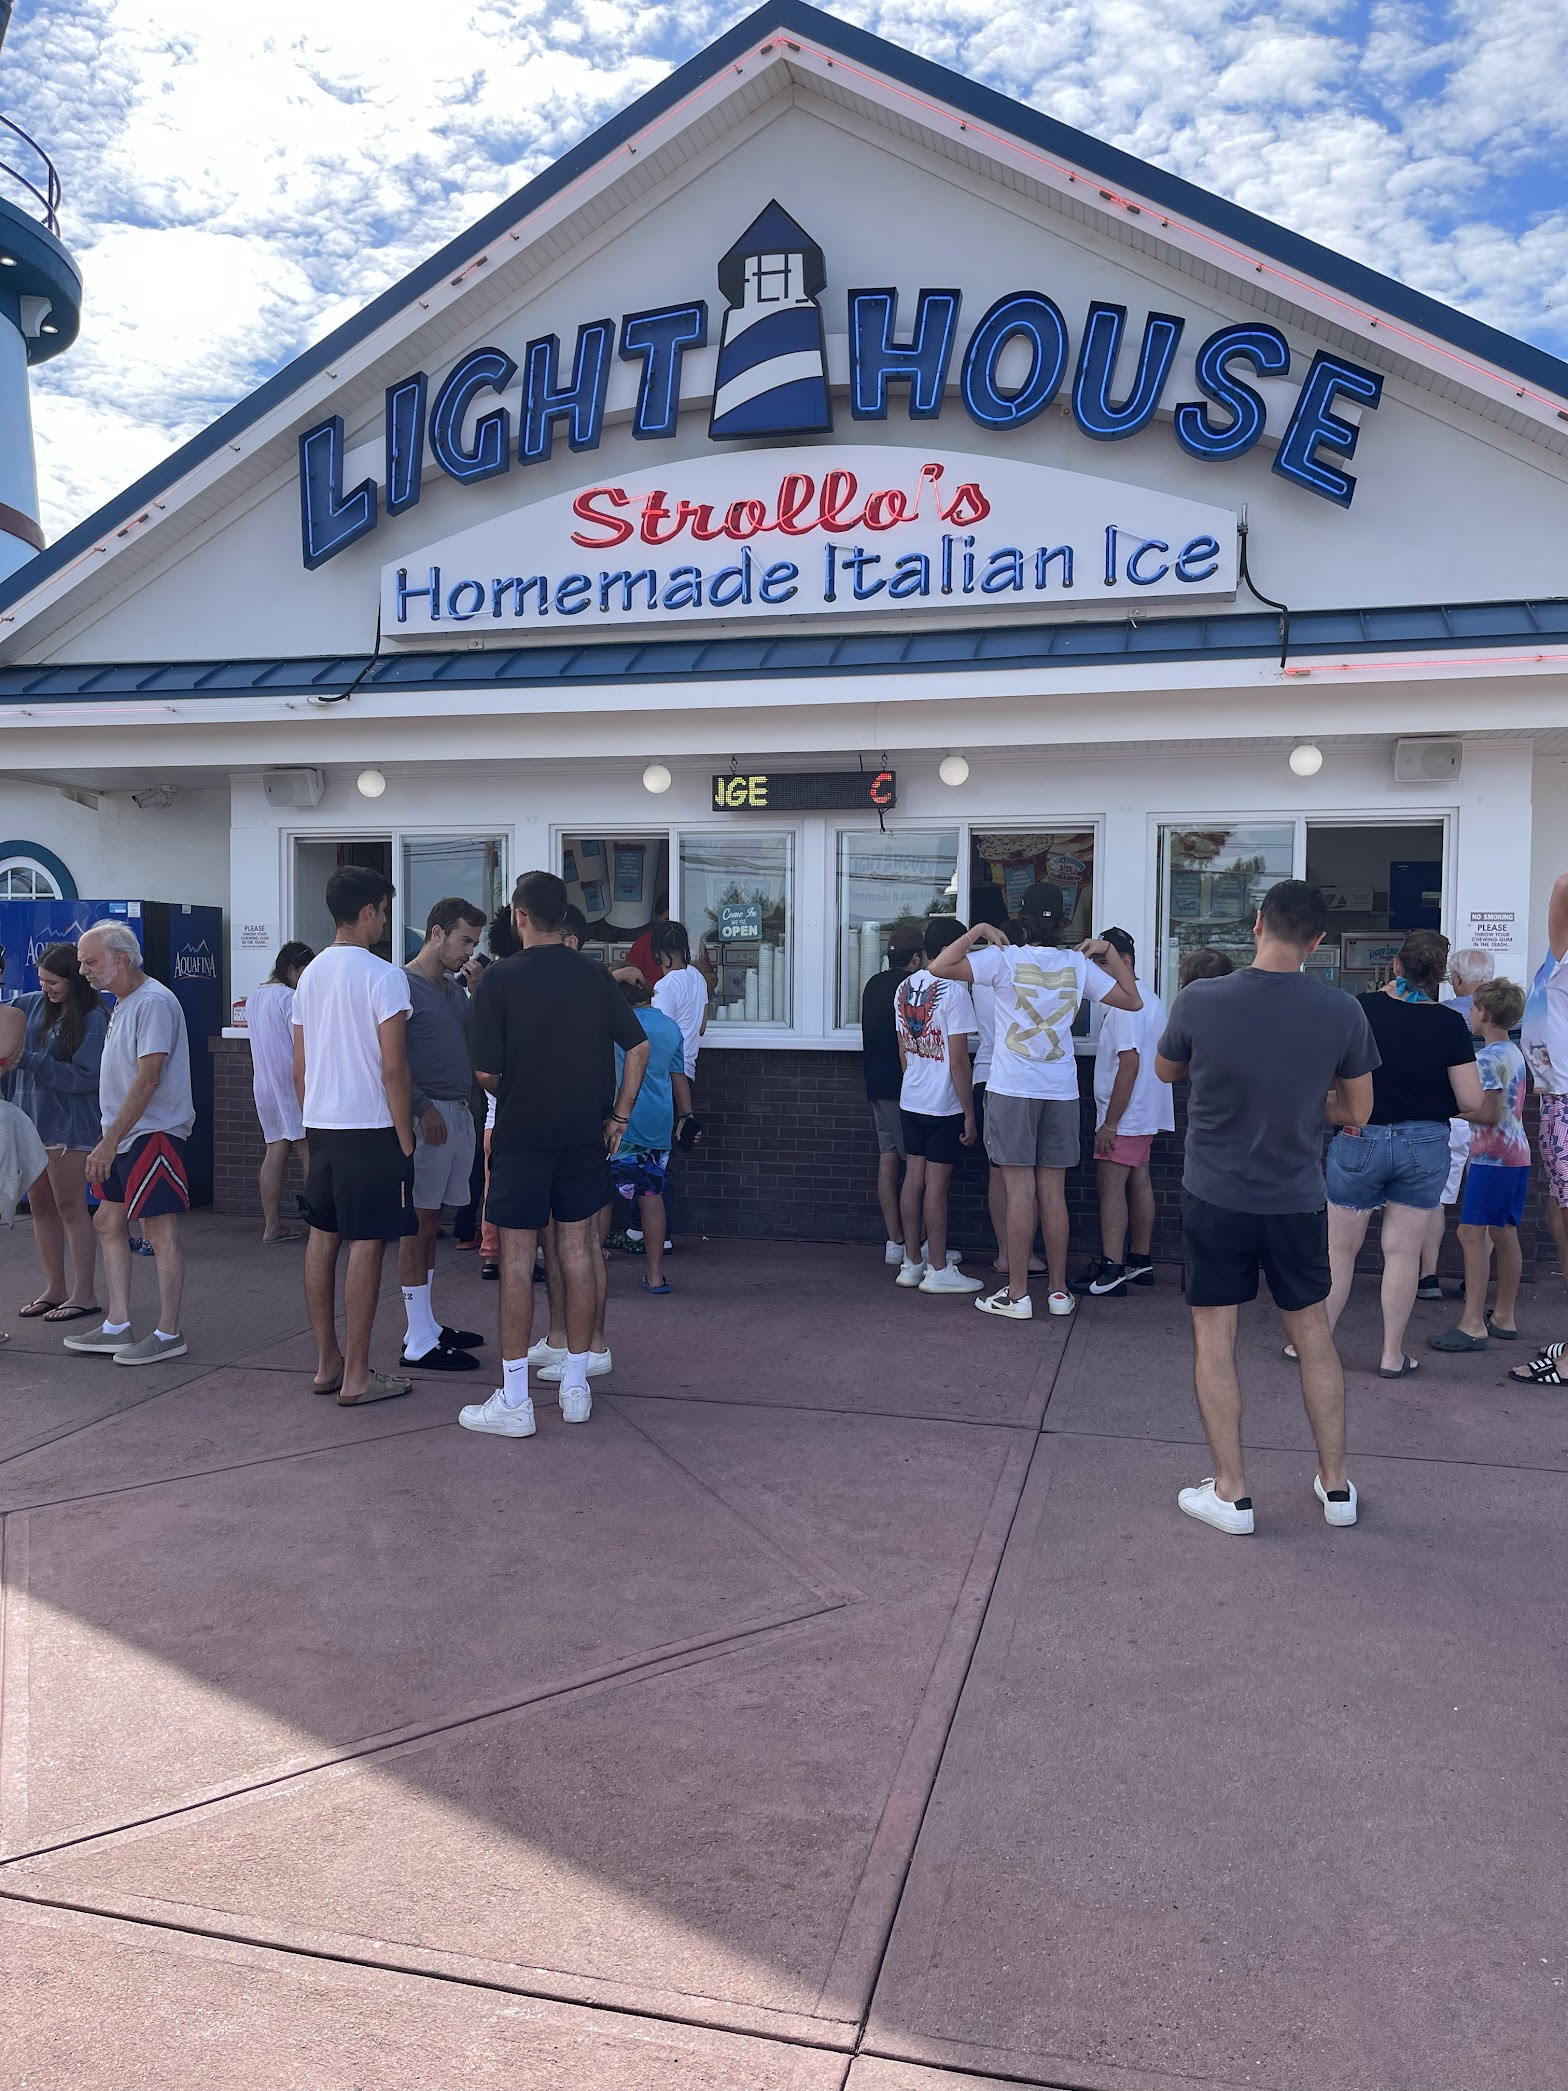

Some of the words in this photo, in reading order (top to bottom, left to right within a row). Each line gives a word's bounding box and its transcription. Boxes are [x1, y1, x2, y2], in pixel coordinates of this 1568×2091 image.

[300, 300, 708, 571] LIGHT
[848, 286, 1385, 509] HOUSE
[571, 463, 991, 549] Strollo's
[396, 545, 799, 622] Homemade
[824, 534, 1074, 602] Italian
[1104, 524, 1220, 587] Ice
[722, 907, 743, 921] Come
[745, 906, 758, 918] In
[1471, 913, 1482, 921] NO
[1483, 913, 1514, 921] SMOKING
[730, 918, 747, 926] WE'RE
[1477, 924, 1508, 932] PLEASE
[722, 924, 758, 938] OPEN
[173, 951, 217, 979] AQUAFINA
